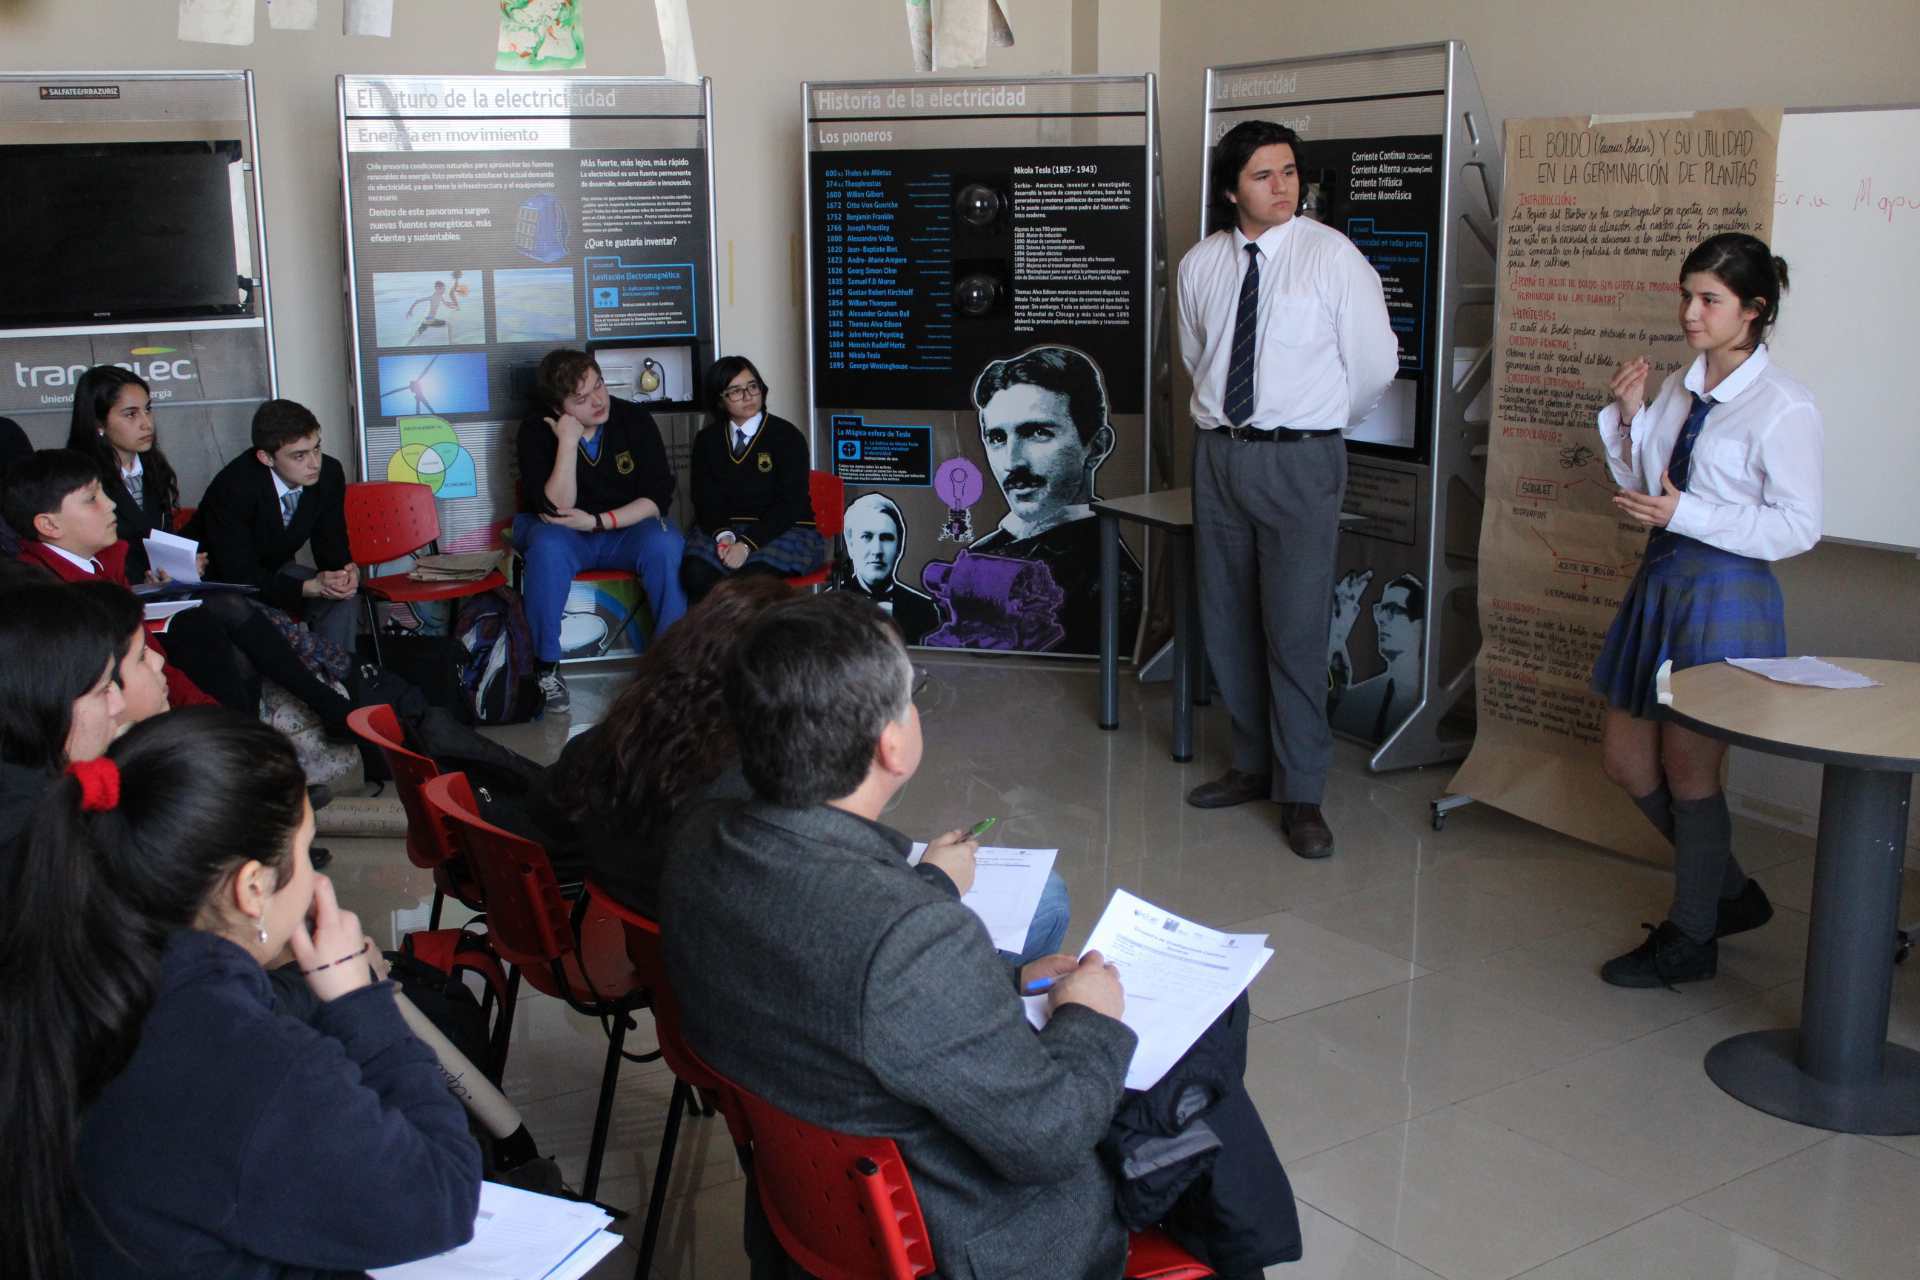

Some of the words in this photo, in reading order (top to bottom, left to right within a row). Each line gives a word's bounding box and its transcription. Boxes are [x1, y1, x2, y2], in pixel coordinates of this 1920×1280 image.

[1231, 72, 1297, 97] electricidad
[357, 88, 373, 109] El
[445, 88, 467, 109] de
[473, 88, 489, 109] la
[818, 91, 881, 111] Historia
[886, 89, 905, 109] de
[911, 88, 925, 108] la
[929, 87, 1026, 108] electricidad
[422, 130, 441, 143] en
[446, 128, 539, 143] movimiento
[819, 130, 839, 144] Los
[842, 129, 893, 146] pioneros
[1519, 134, 1535, 159] EL
[1545, 131, 1591, 158] BOLDO
[1659, 130, 1672, 155] Y
[1674, 129, 1692, 155] SU
[1697, 129, 1753, 158] UTILIDAD
[580, 158, 596, 167] Más
[620, 158, 635, 167] más
[654, 158, 668, 167] más
[668, 157, 689, 168] rápido
[1352, 152, 1378, 162] Corriente
[1013, 166, 1034, 175] Nikola
[1034, 165, 1051, 175] Tesla
[1351, 165, 1378, 175] Corriente
[1379, 162, 1401, 174] Alterna
[1537, 161, 1556, 184] EN
[1563, 162, 1577, 185] LA
[1583, 158, 1669, 186] GERMINACIÓN
[1679, 160, 1698, 185] DE
[1703, 160, 1760, 187] PLANTAS
[1350, 178, 1377, 188] Corriente
[1350, 191, 1377, 201] Corriente
[368, 208, 397, 217] Dentro
[398, 207, 407, 216] de
[407, 208, 425, 216] este
[425, 208, 464, 218] panorama
[398, 219, 428, 229] fuentes
[605, 239, 614, 248] te
[643, 236, 678, 247] inventar?
[41, 394, 74, 404] Uniend
